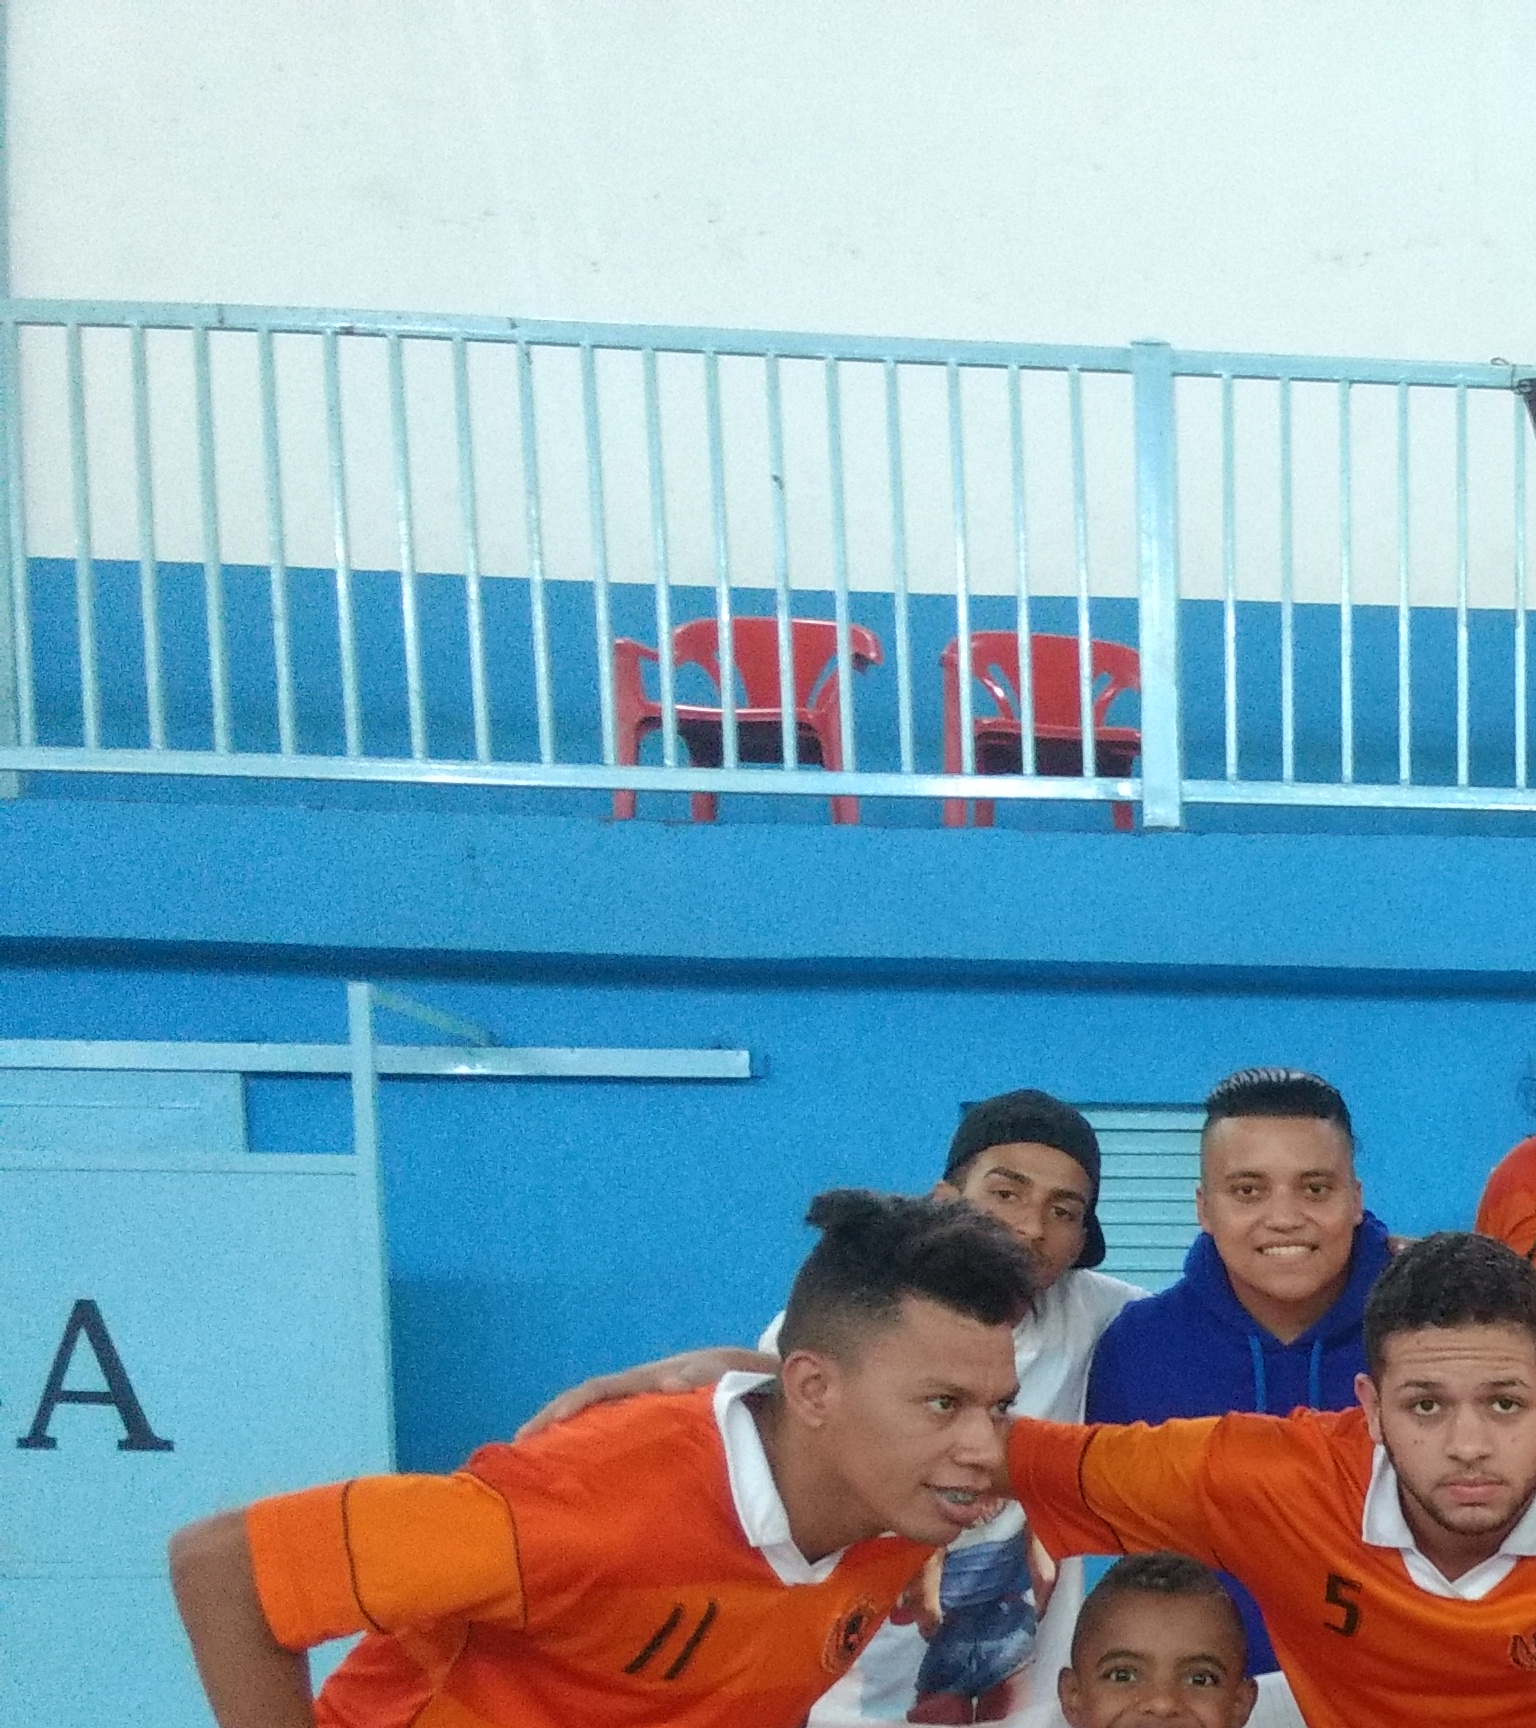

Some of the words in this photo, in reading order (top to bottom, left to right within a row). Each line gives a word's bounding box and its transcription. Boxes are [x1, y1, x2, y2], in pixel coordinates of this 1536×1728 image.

[16, 1298, 175, 1451] A
[625, 1600, 717, 1681] 11
[1324, 1572, 1364, 1637] 5
